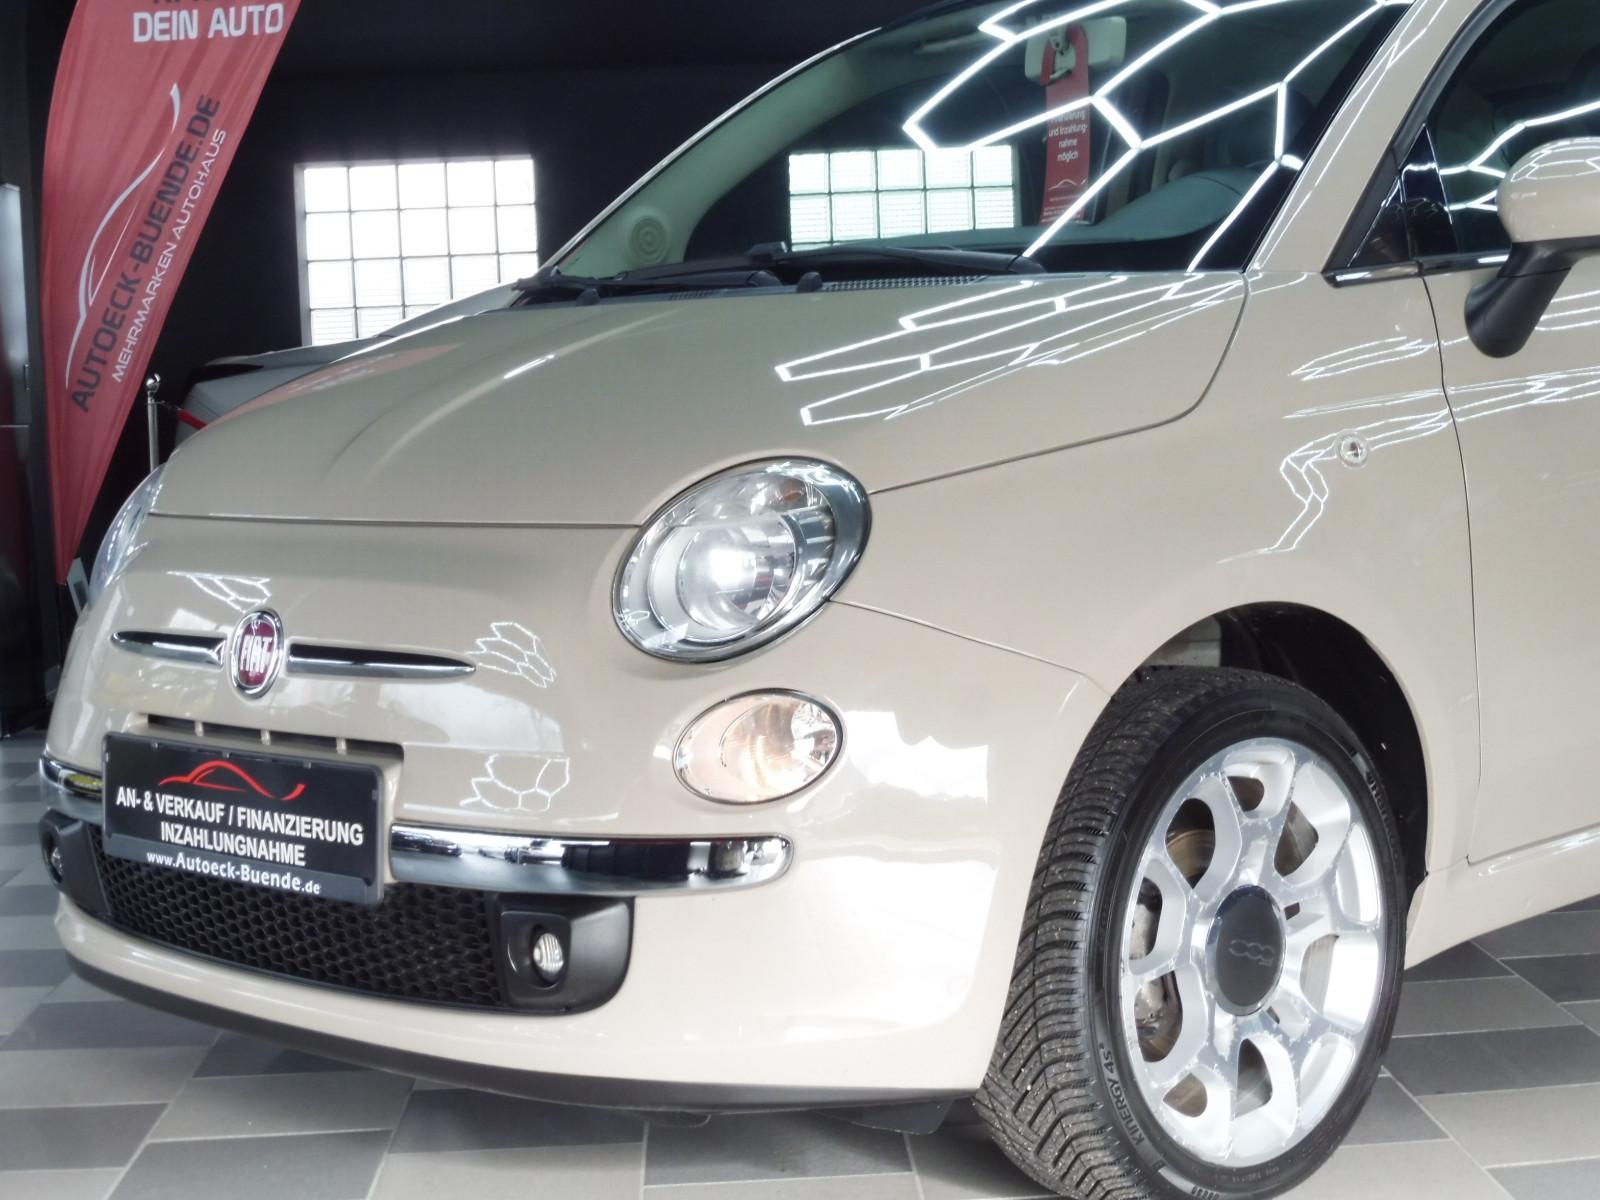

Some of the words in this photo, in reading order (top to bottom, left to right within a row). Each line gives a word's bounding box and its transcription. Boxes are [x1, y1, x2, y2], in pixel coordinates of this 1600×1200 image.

[133, 9, 199, 43] DEIN
[207, 3, 284, 39] AUTO
[1048, 127, 1059, 137] und
[1058, 138, 1078, 149] nahme
[1056, 150, 1079, 162] möglich
[71, 93, 221, 412] AUTOECK-BUENDE.DE
[111, 240, 176, 383] MEHRMARKEN
[174, 128, 227, 240] AUTOHAUS
[240, 634, 273, 674] FIAT
[116, 786, 141, 809] AN-
[144, 790, 153, 811] &
[155, 793, 225, 825] VERKAUF
[228, 805, 235, 826] /
[237, 806, 364, 846] FINANZIERUNG
[160, 821, 306, 867] INZAHLUNGNAHME
[146, 851, 321, 895] www.Autoeck-Buende.de
